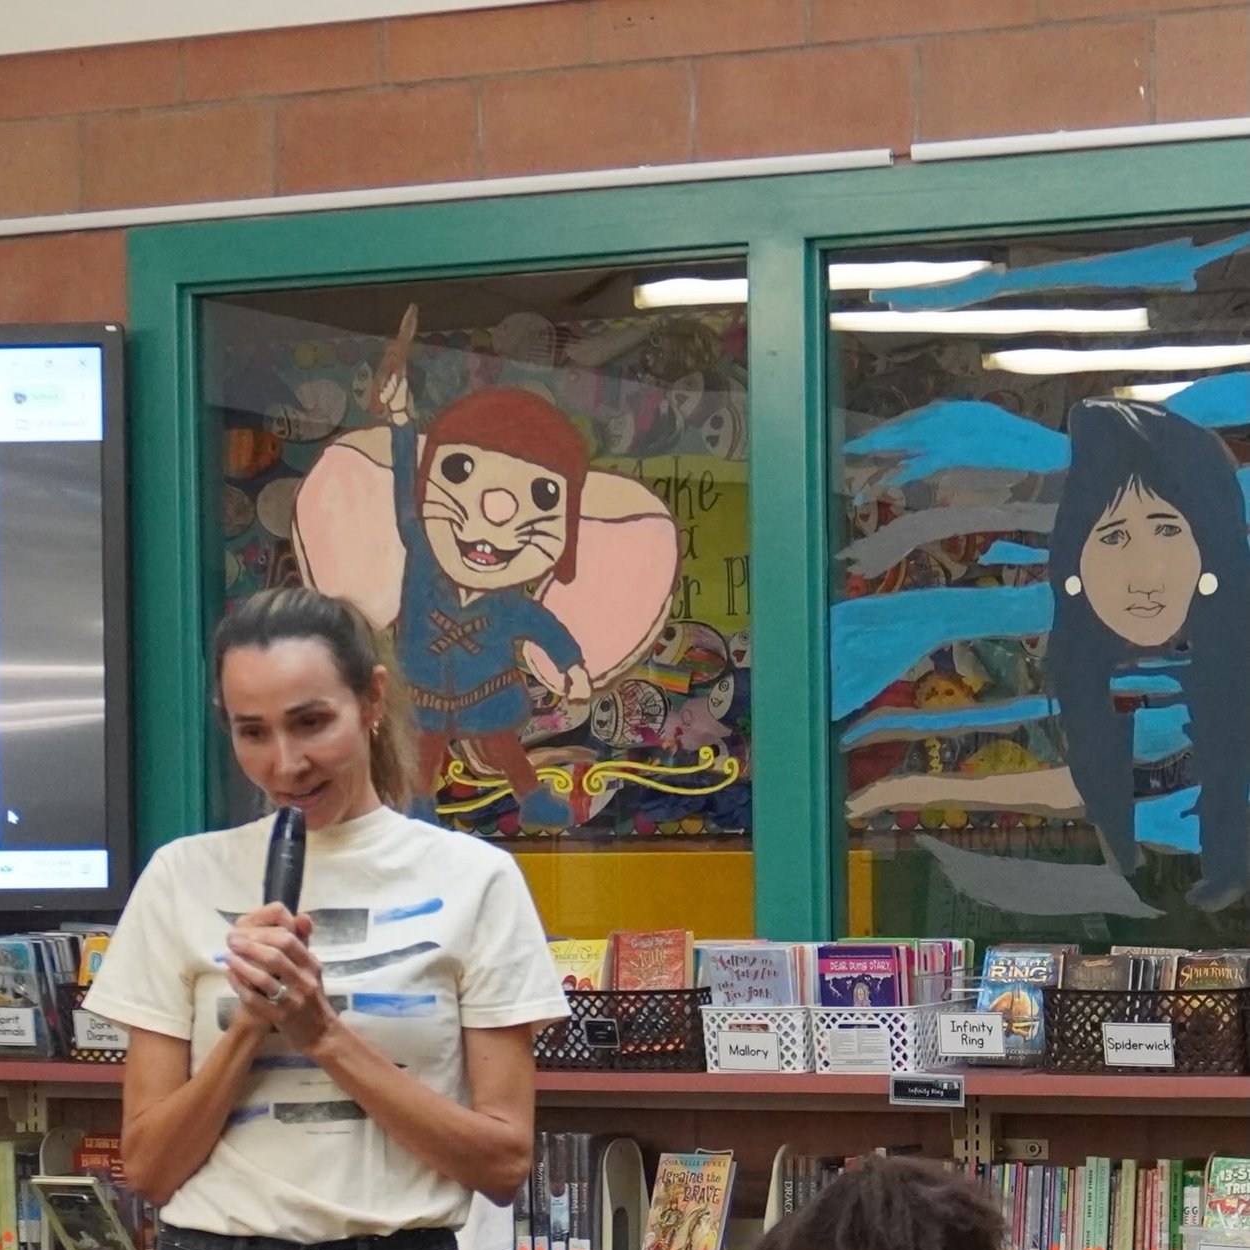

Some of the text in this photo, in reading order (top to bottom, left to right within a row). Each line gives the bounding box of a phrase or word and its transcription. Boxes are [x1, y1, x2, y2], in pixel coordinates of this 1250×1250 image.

[829, 961, 847, 972] DEAR
[989, 964, 1051, 982] RING
[950, 1020, 994, 1036] Infinity
[86, 1031, 120, 1043] Diaries
[960, 1034, 985, 1049] Ring
[1107, 1037, 1171, 1052] Spiderwick
[728, 1044, 769, 1059] Mallory
[706, 1171, 722, 1183] the
[683, 1185, 722, 1205] BRAVE
